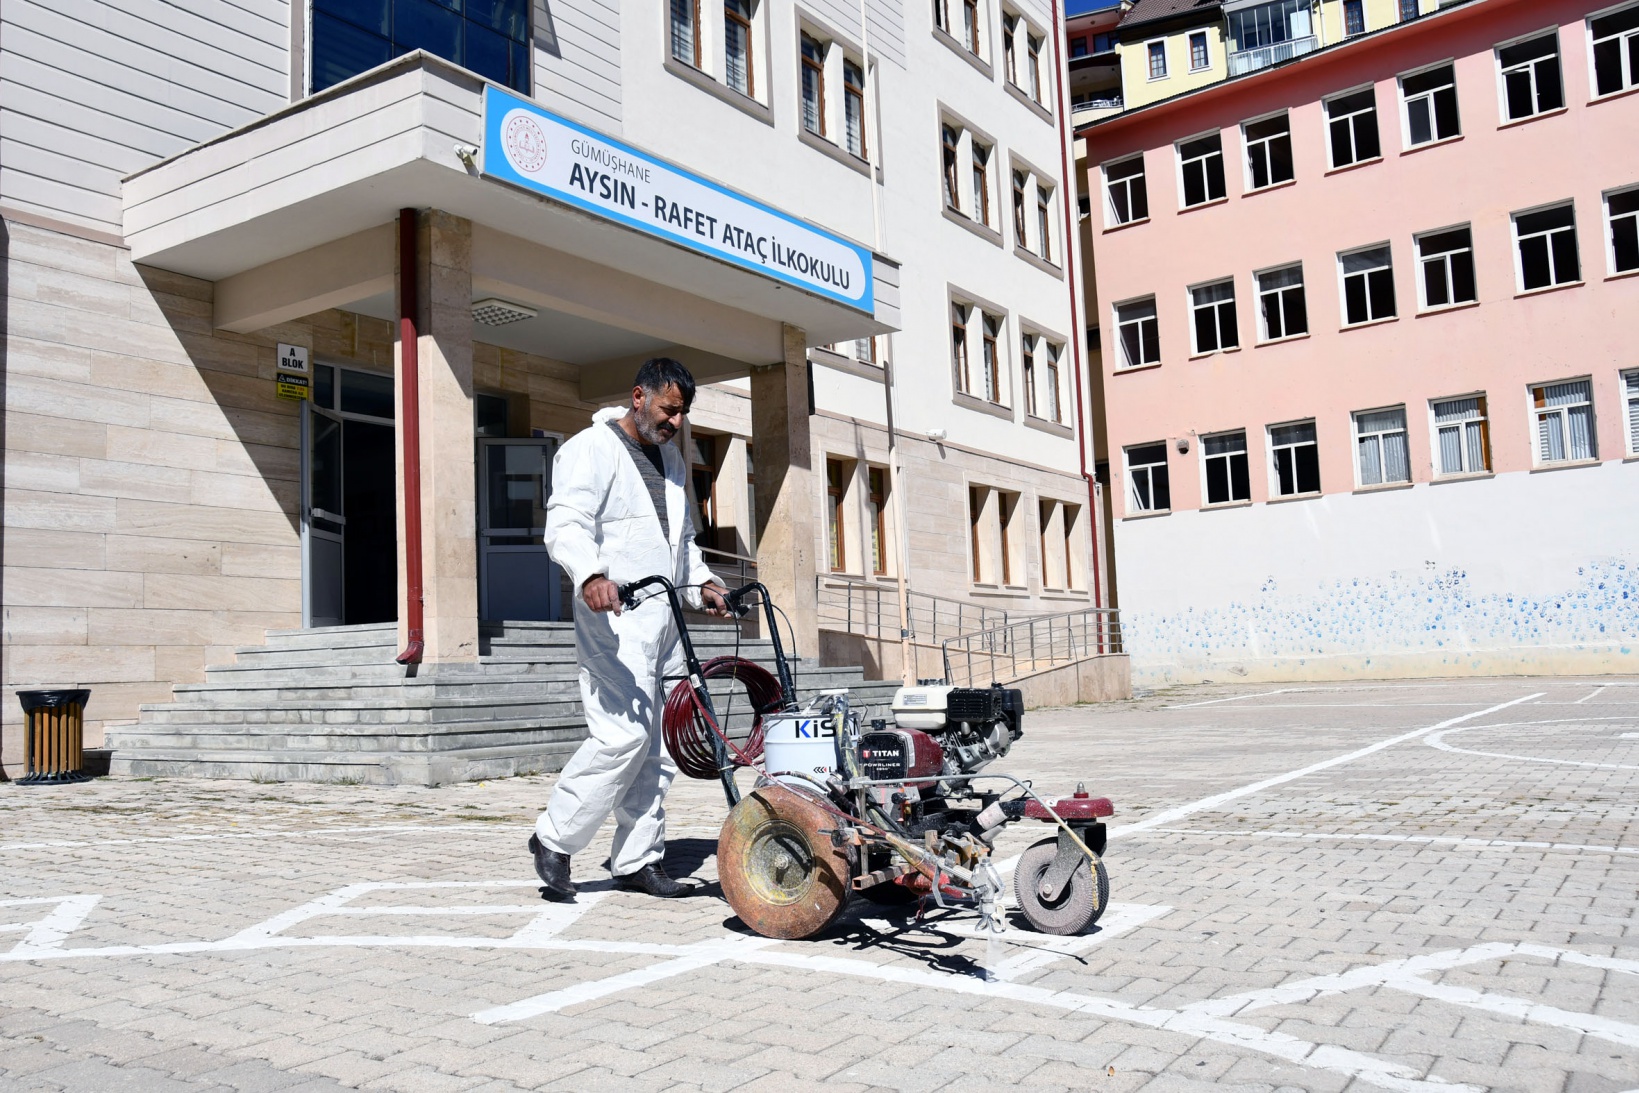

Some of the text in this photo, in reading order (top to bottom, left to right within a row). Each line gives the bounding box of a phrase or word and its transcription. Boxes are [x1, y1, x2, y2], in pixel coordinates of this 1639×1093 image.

[571, 139, 651, 184] GÜMÜŞHANE
[569, 162, 635, 210] AYSIN
[655, 194, 717, 240] RAFET
[722, 223, 767, 264] ATAÇ
[772, 235, 849, 290] İLKOKULU
[281, 357, 304, 369] BLOK
[289, 347, 296, 357] A
